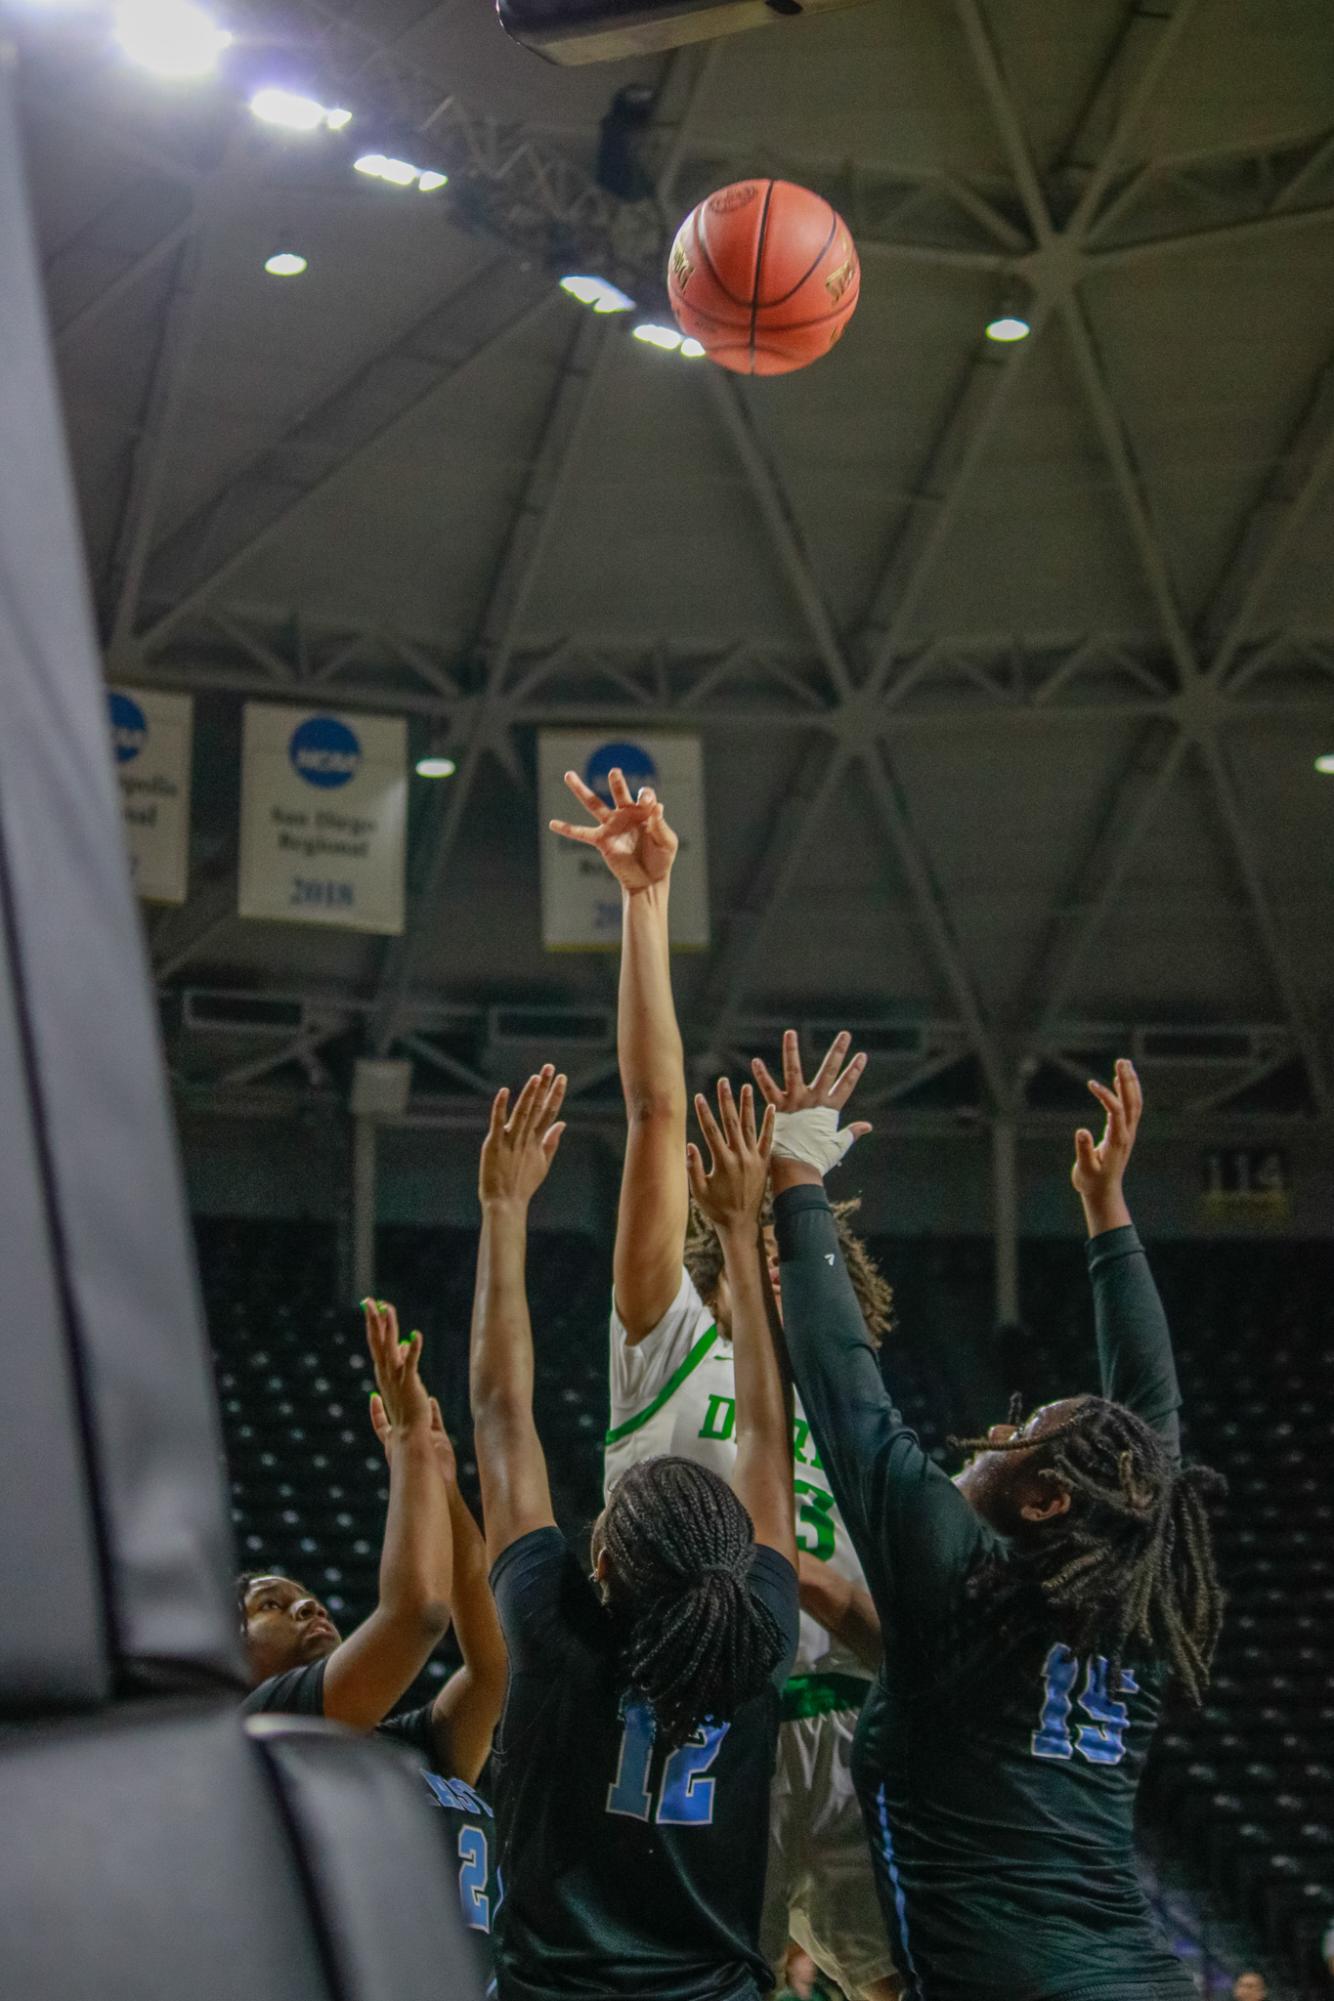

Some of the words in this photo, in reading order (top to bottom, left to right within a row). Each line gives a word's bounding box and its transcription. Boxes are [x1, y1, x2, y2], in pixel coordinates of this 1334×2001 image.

[605, 1690, 731, 1825] 12
[1031, 1642, 1140, 1765] 15
[458, 1824, 490, 1934] 2
